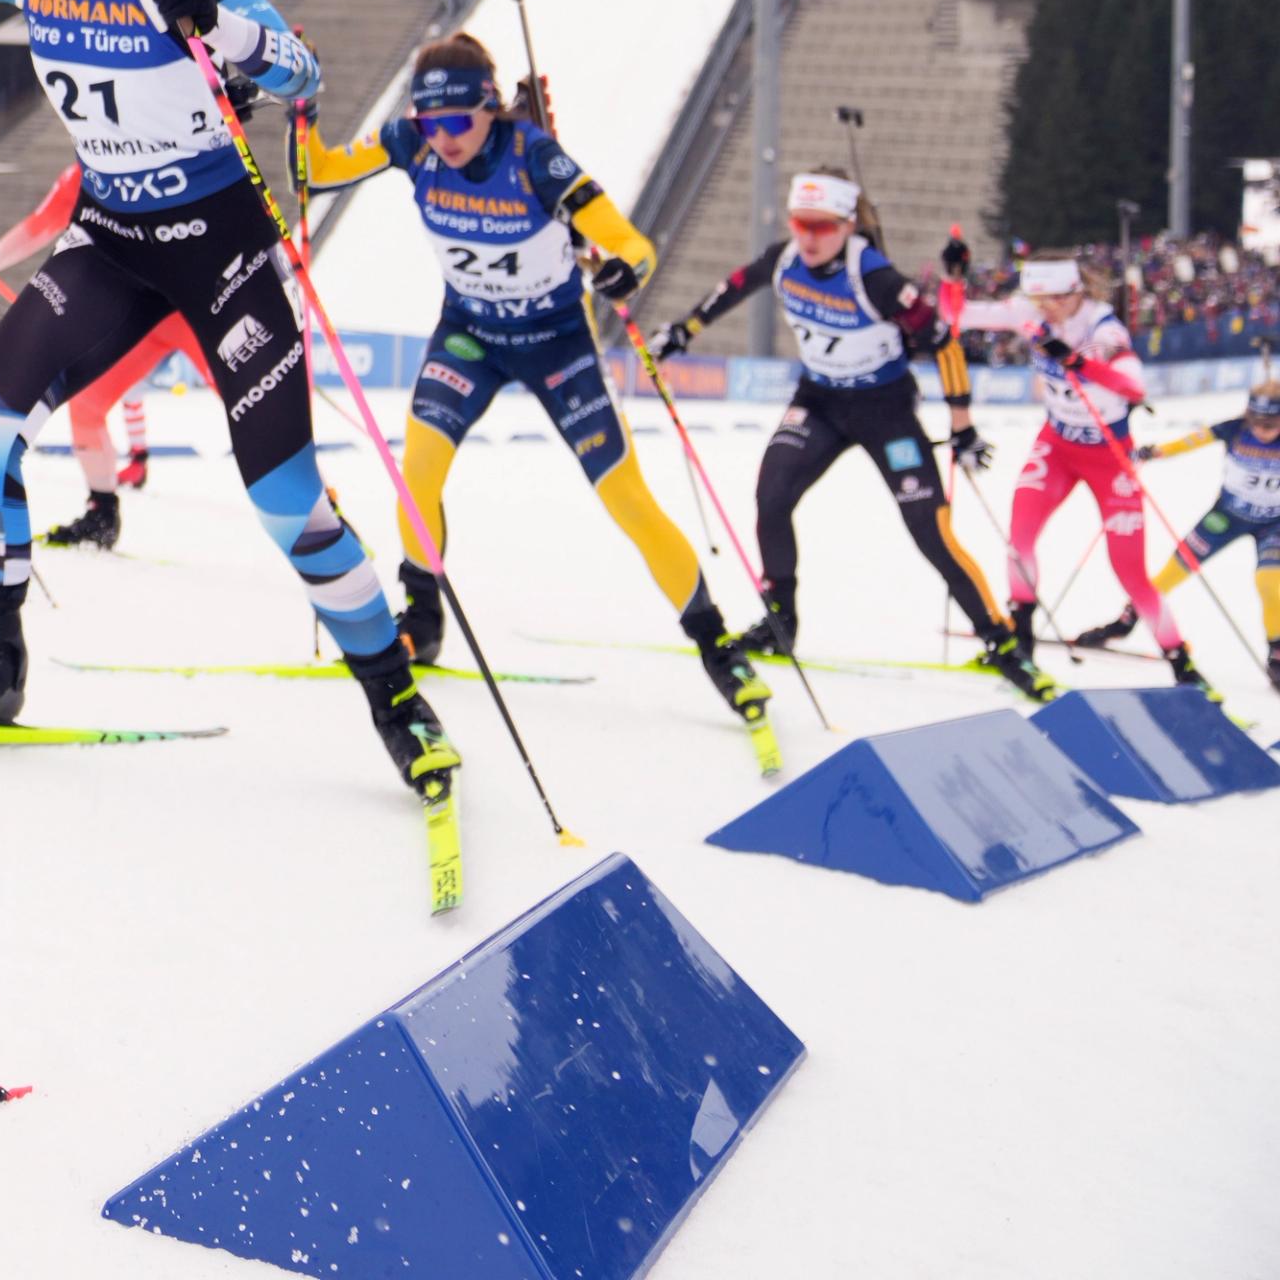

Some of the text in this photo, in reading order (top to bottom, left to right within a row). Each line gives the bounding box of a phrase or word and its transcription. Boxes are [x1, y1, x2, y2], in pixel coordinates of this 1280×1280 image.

[80, 26, 151, 54] Türen
[45, 71, 120, 126] 21
[482, 217, 532, 235] Doors
[210, 250, 269, 315] CARGLASS
[446, 247, 522, 277] 24
[226, 327, 275, 373] FERE
[230, 340, 305, 422] moomoo
